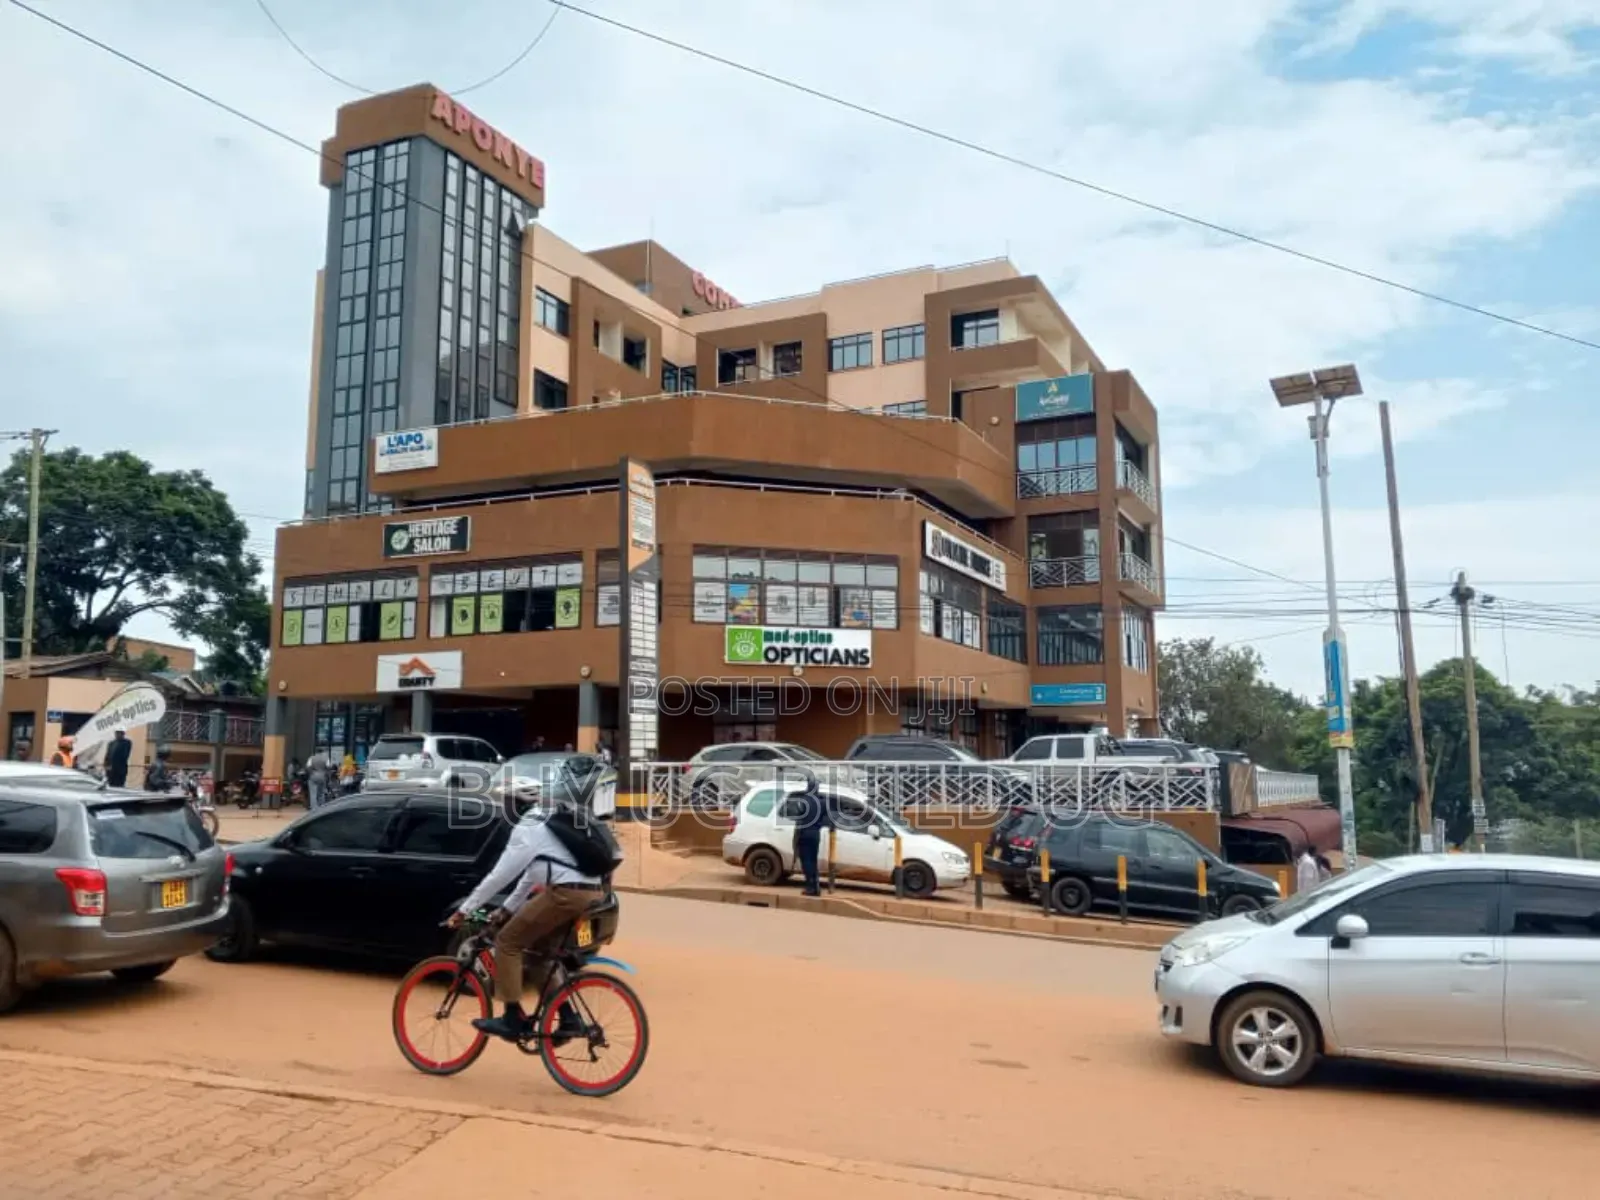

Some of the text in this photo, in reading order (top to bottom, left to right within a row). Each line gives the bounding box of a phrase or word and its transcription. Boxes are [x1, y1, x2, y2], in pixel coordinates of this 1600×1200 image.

[430, 91, 545, 190] APONYE
[387, 432, 424, 448] L'APO
[408, 519, 459, 538] HERITAGE
[413, 536, 452, 554] SALON
[763, 646, 870, 666] OPTICIANS
